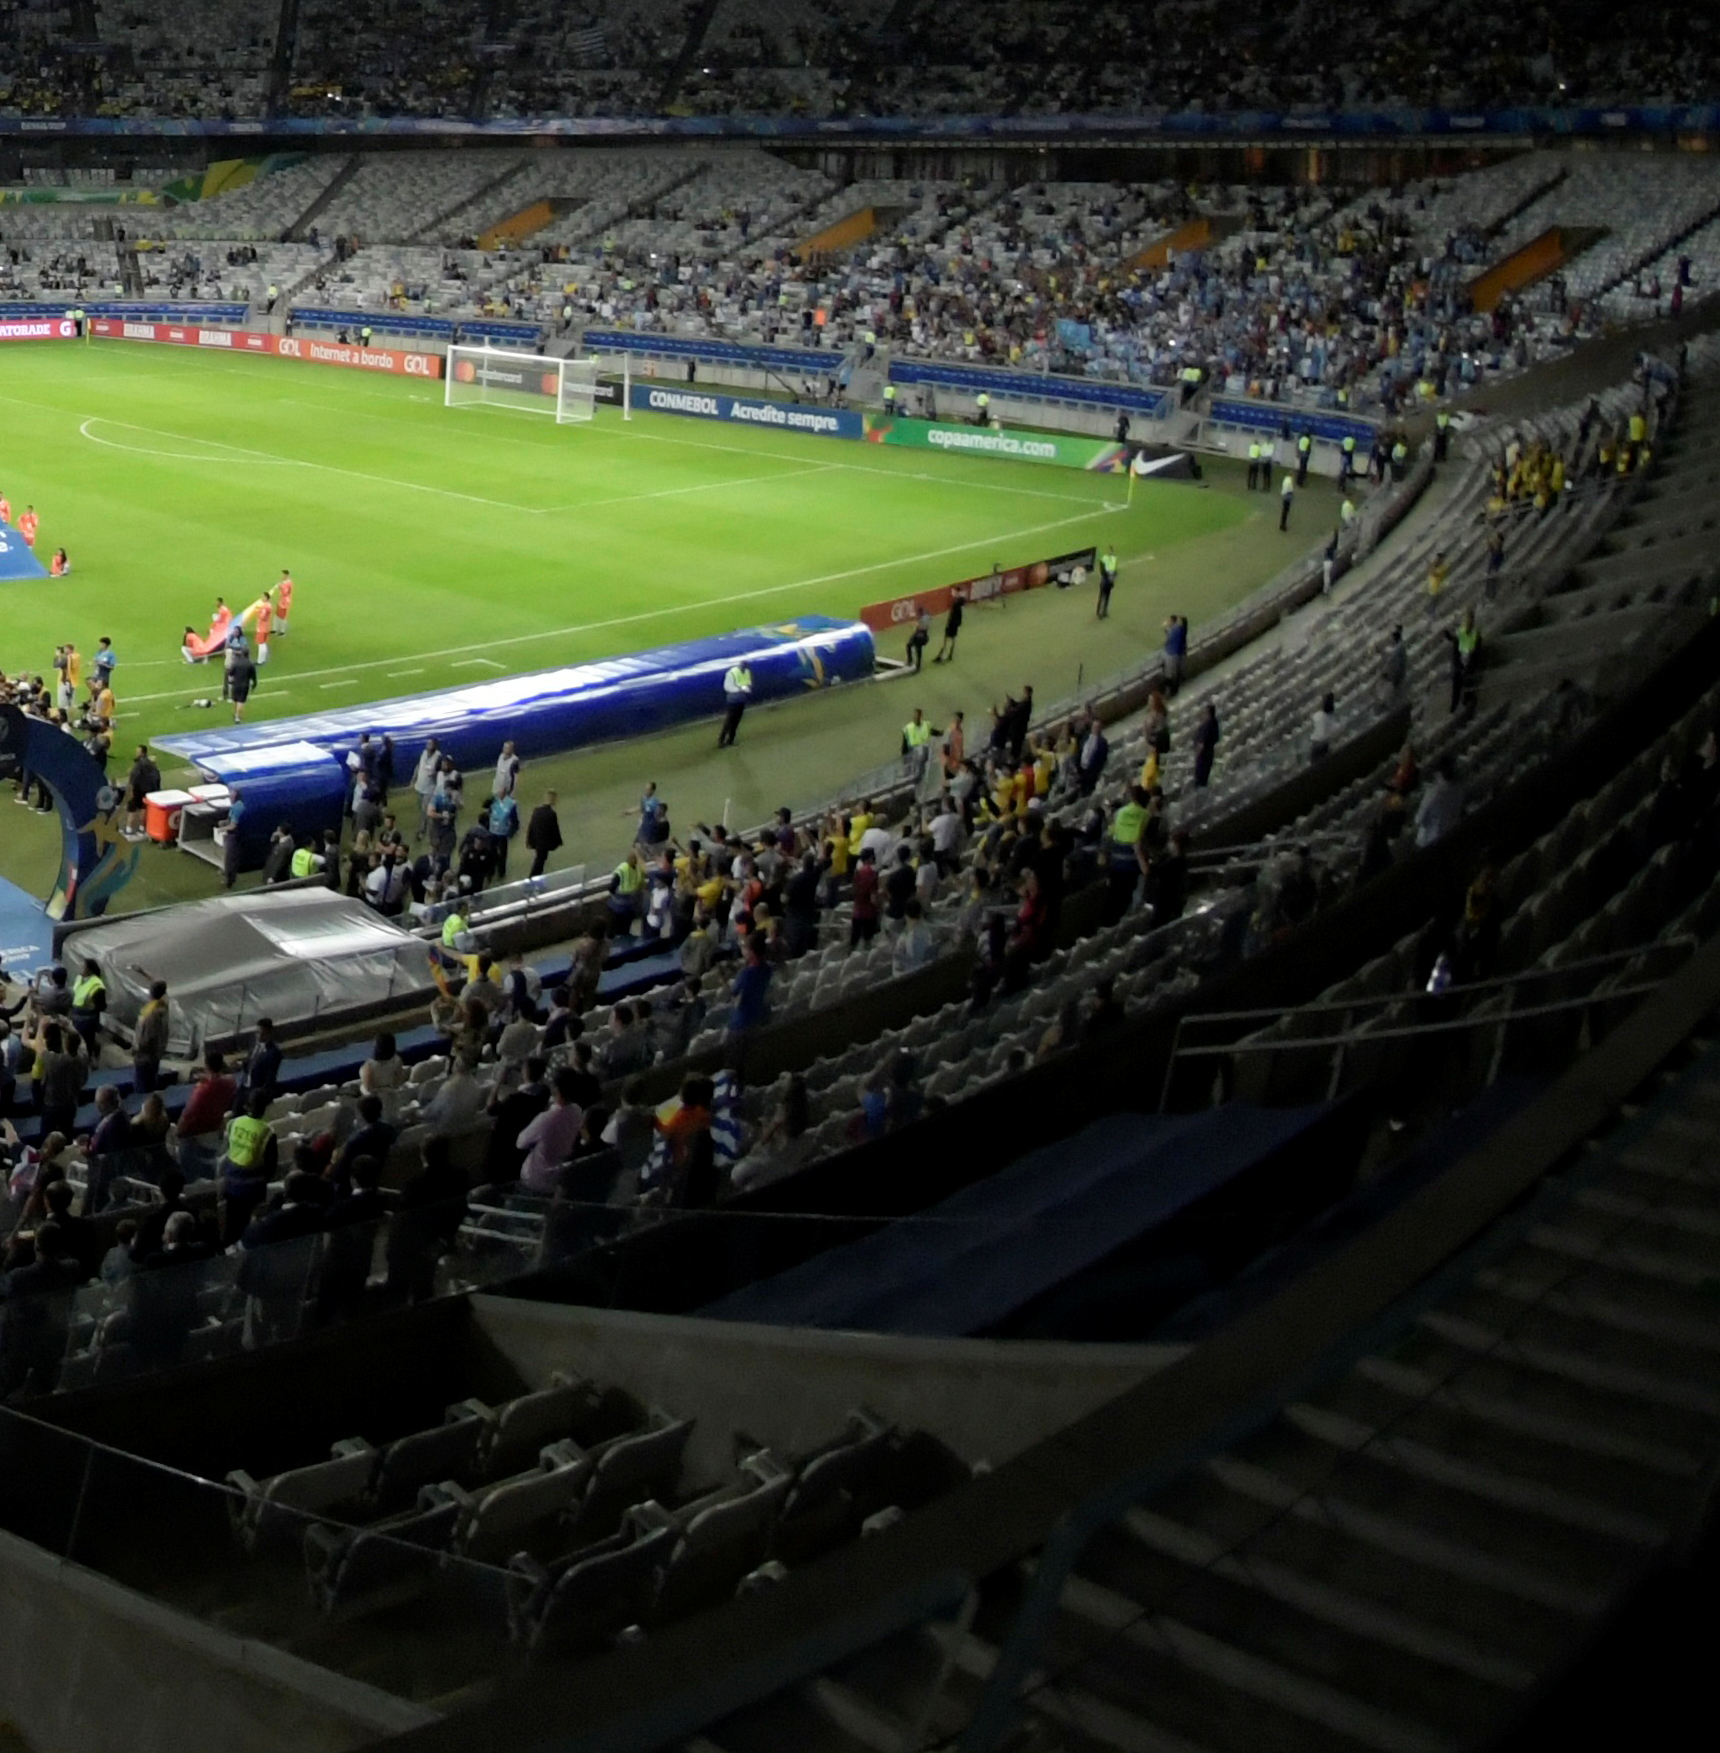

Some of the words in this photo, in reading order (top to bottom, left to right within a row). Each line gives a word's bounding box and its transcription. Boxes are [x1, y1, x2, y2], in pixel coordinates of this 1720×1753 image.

[60, 321, 72, 336] G
[278, 338, 302, 357] GOL
[310, 343, 351, 364] Internet
[352, 351, 362, 364] a
[361, 348, 393, 369] bordo
[404, 355, 430, 376] GOL
[649, 389, 720, 416] CONMEBOL
[730, 401, 786, 425] Acredite
[927, 429, 1057, 458] copaamerica.com
[890, 599, 917, 623] GOL
